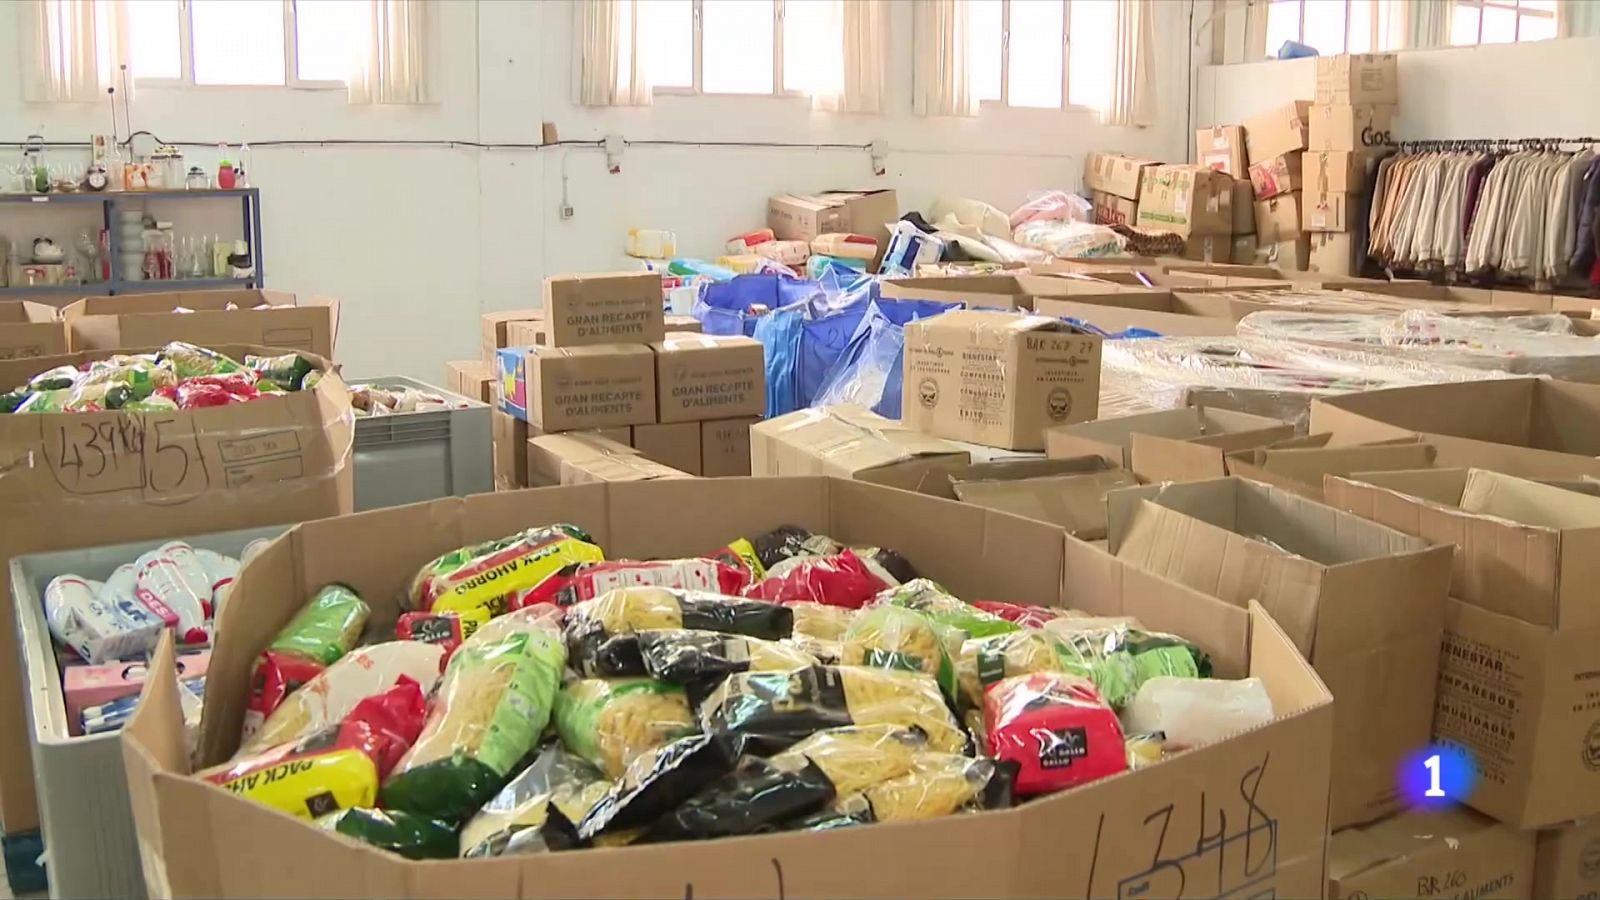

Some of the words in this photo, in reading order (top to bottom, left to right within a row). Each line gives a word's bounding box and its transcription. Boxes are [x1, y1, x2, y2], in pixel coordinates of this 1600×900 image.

[567, 313, 599, 326] GRAN
[577, 323, 643, 337] D'ALIMENTS
[671, 385, 703, 397] GRAN
[706, 381, 753, 394] RECAPTE
[555, 393, 588, 406] GRAN
[591, 391, 641, 402] RECAPTE
[682, 393, 745, 408] D'ALIMENTS
[565, 403, 633, 416] D'ALIMENTS
[455, 560, 518, 595] AHORRO
[263, 760, 314, 785] PACK
